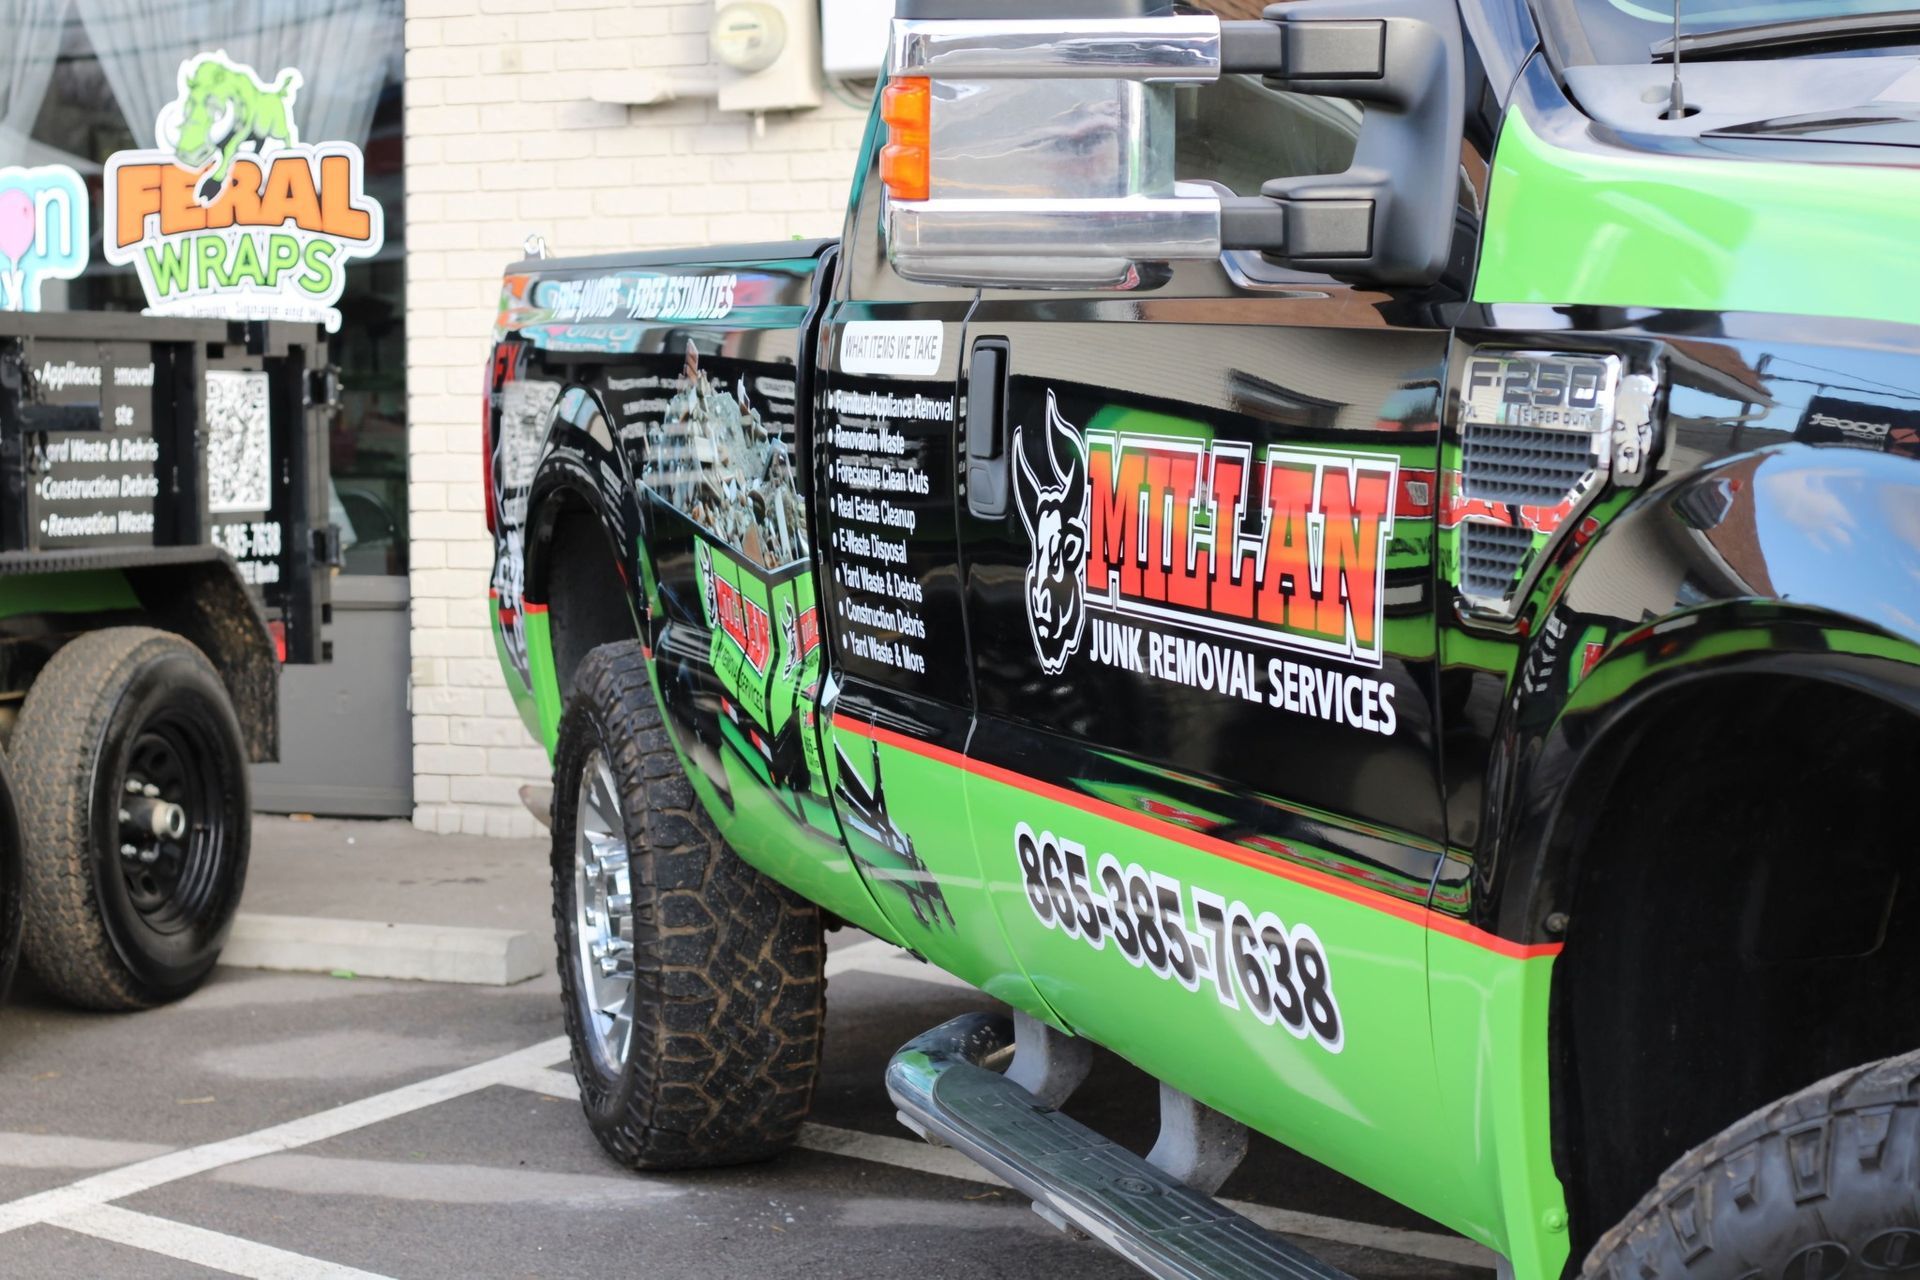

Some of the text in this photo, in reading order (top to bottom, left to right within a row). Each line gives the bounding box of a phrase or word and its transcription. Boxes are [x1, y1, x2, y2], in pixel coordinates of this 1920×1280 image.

[116, 155, 371, 249] FERAL
[144, 233, 335, 296] WRAPS
[627, 278, 667, 319] FREE
[658, 274, 737, 319] ESTIMATES
[844, 335, 939, 360] WHAT ITEMS WE TAKE
[114, 362, 155, 387] emoval
[914, 394, 954, 421] Removal
[1523, 409, 1595, 426] SUPER DUTY
[46, 438, 69, 462] ard
[835, 424, 905, 455] Renovation Waste
[42, 475, 120, 500] Construction
[836, 458, 930, 495] Foreclosure Clean Outs
[48, 512, 117, 537] Renovation
[837, 493, 916, 535] Real Estate Cleanup
[839, 527, 908, 566] E-Waste Disposal
[1086, 444, 1392, 646] MILLAN
[841, 562, 923, 603] Yard Waste & Debris
[845, 596, 926, 639] Construction Debris
[849, 630, 867, 655] Yard
[867, 634, 893, 665] Waste
[894, 643, 903, 668] &
[902, 644, 926, 674] More
[1089, 618, 1397, 736] JUNK REMOVAL SERVICES
[1017, 830, 1341, 1048] 865-385-7638
